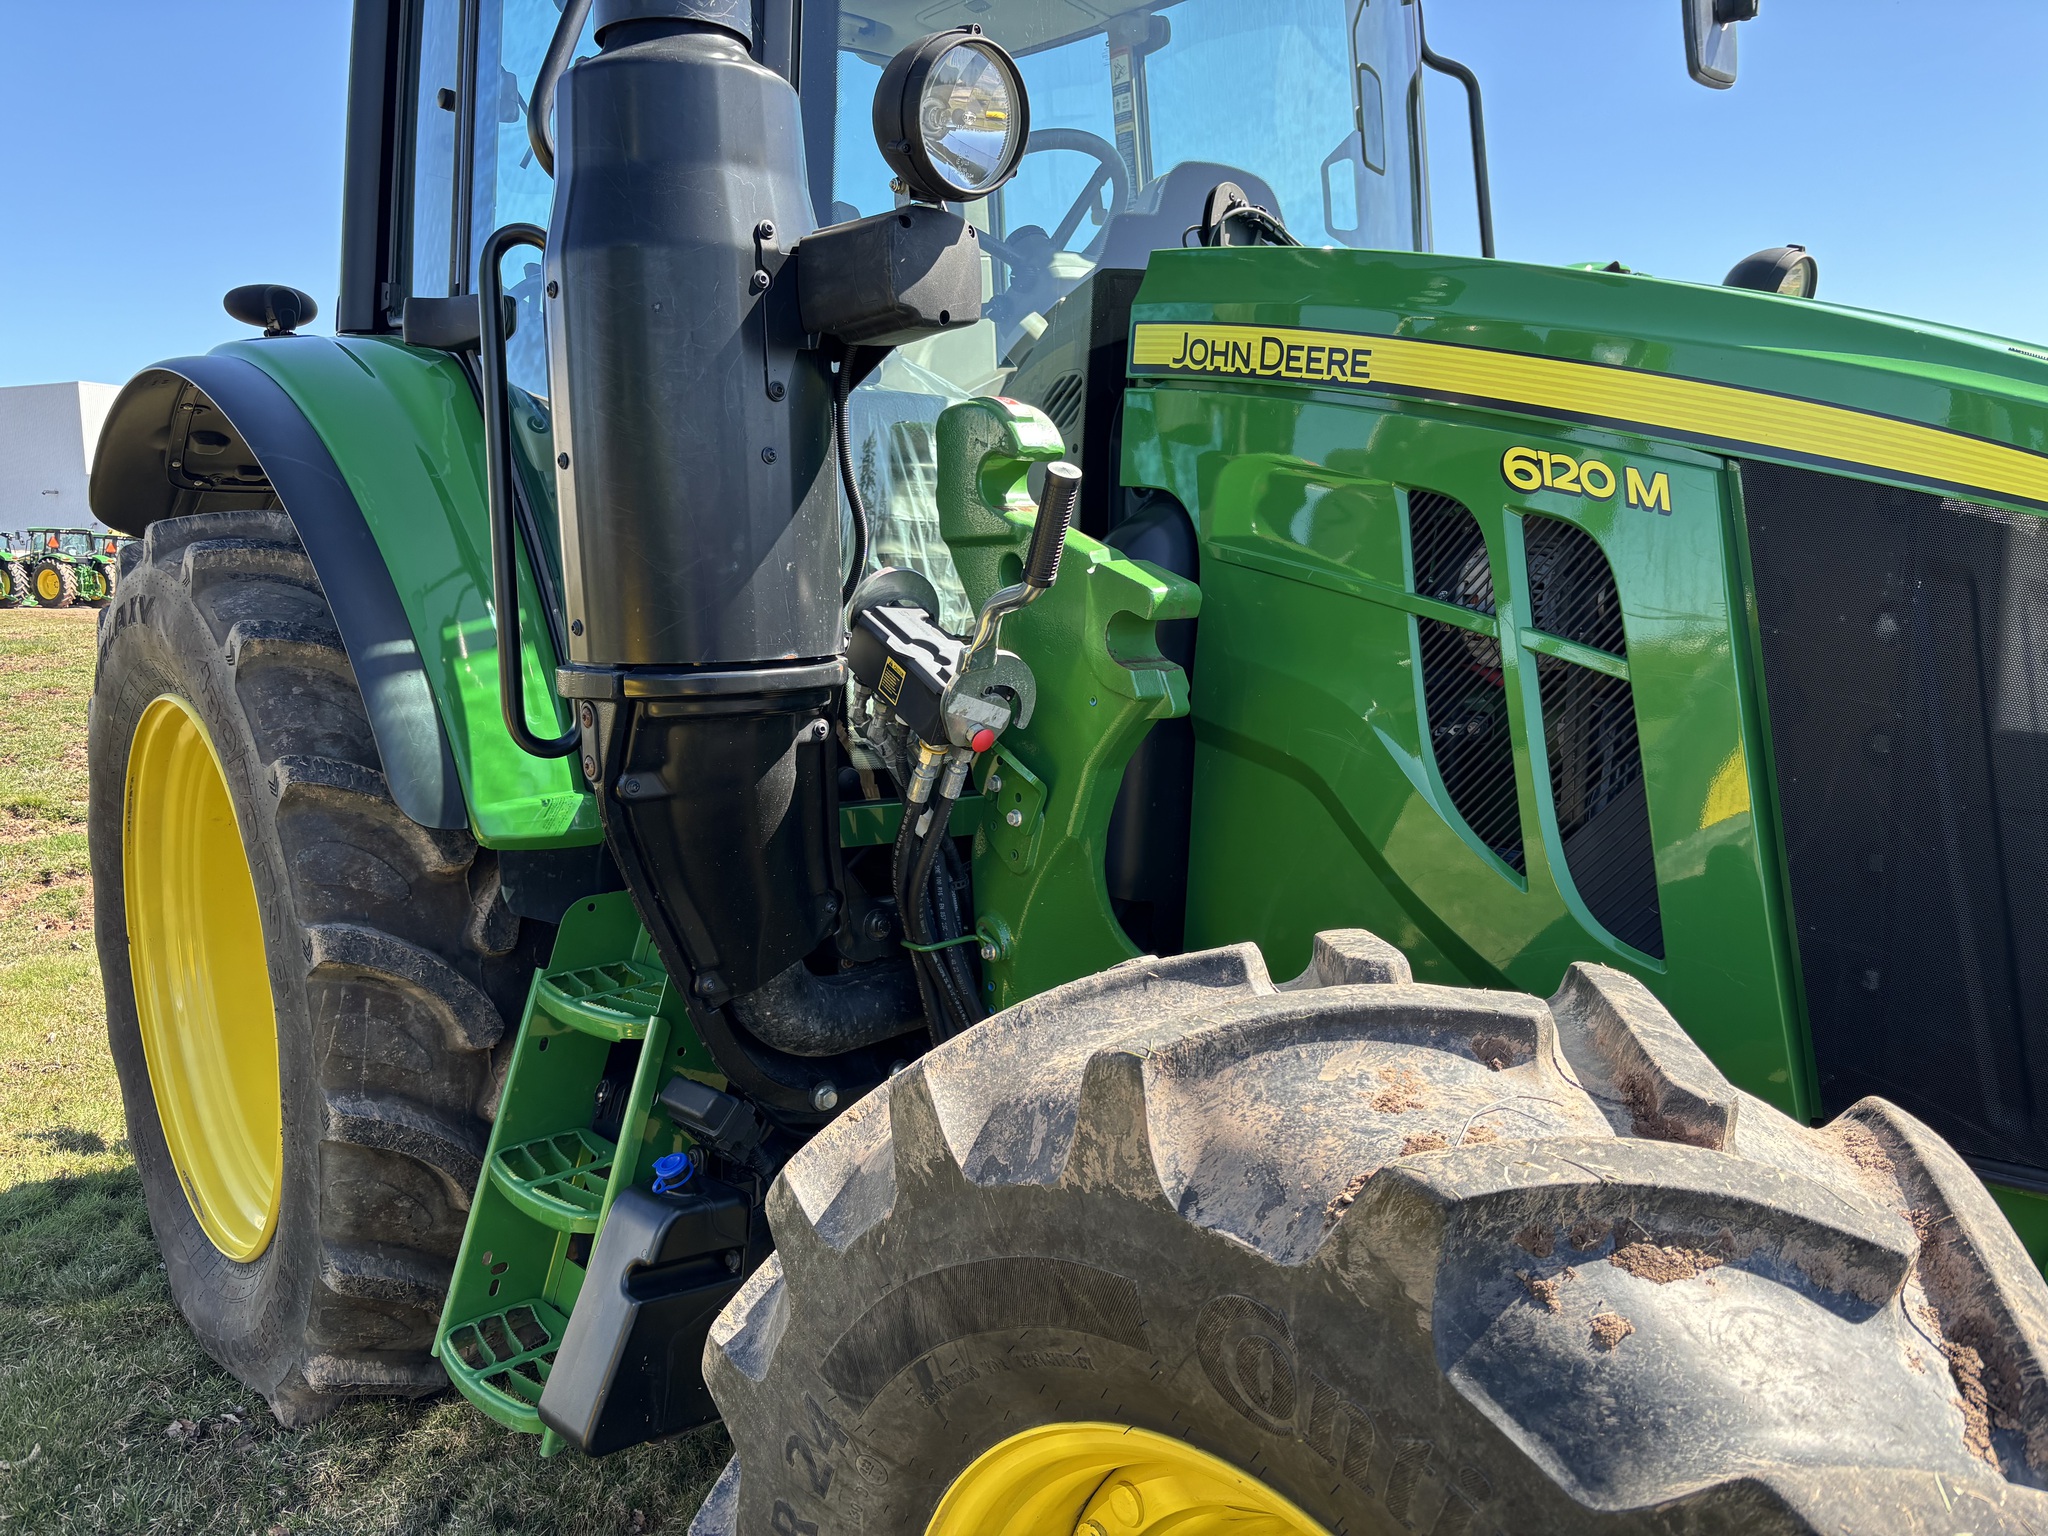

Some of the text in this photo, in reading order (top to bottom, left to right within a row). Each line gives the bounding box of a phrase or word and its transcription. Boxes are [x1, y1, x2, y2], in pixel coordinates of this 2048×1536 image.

[1172, 332, 1373, 381] JOHN DEERE
[1501, 446, 1673, 515] 6120 M
[785, 1390, 849, 1500] 24
